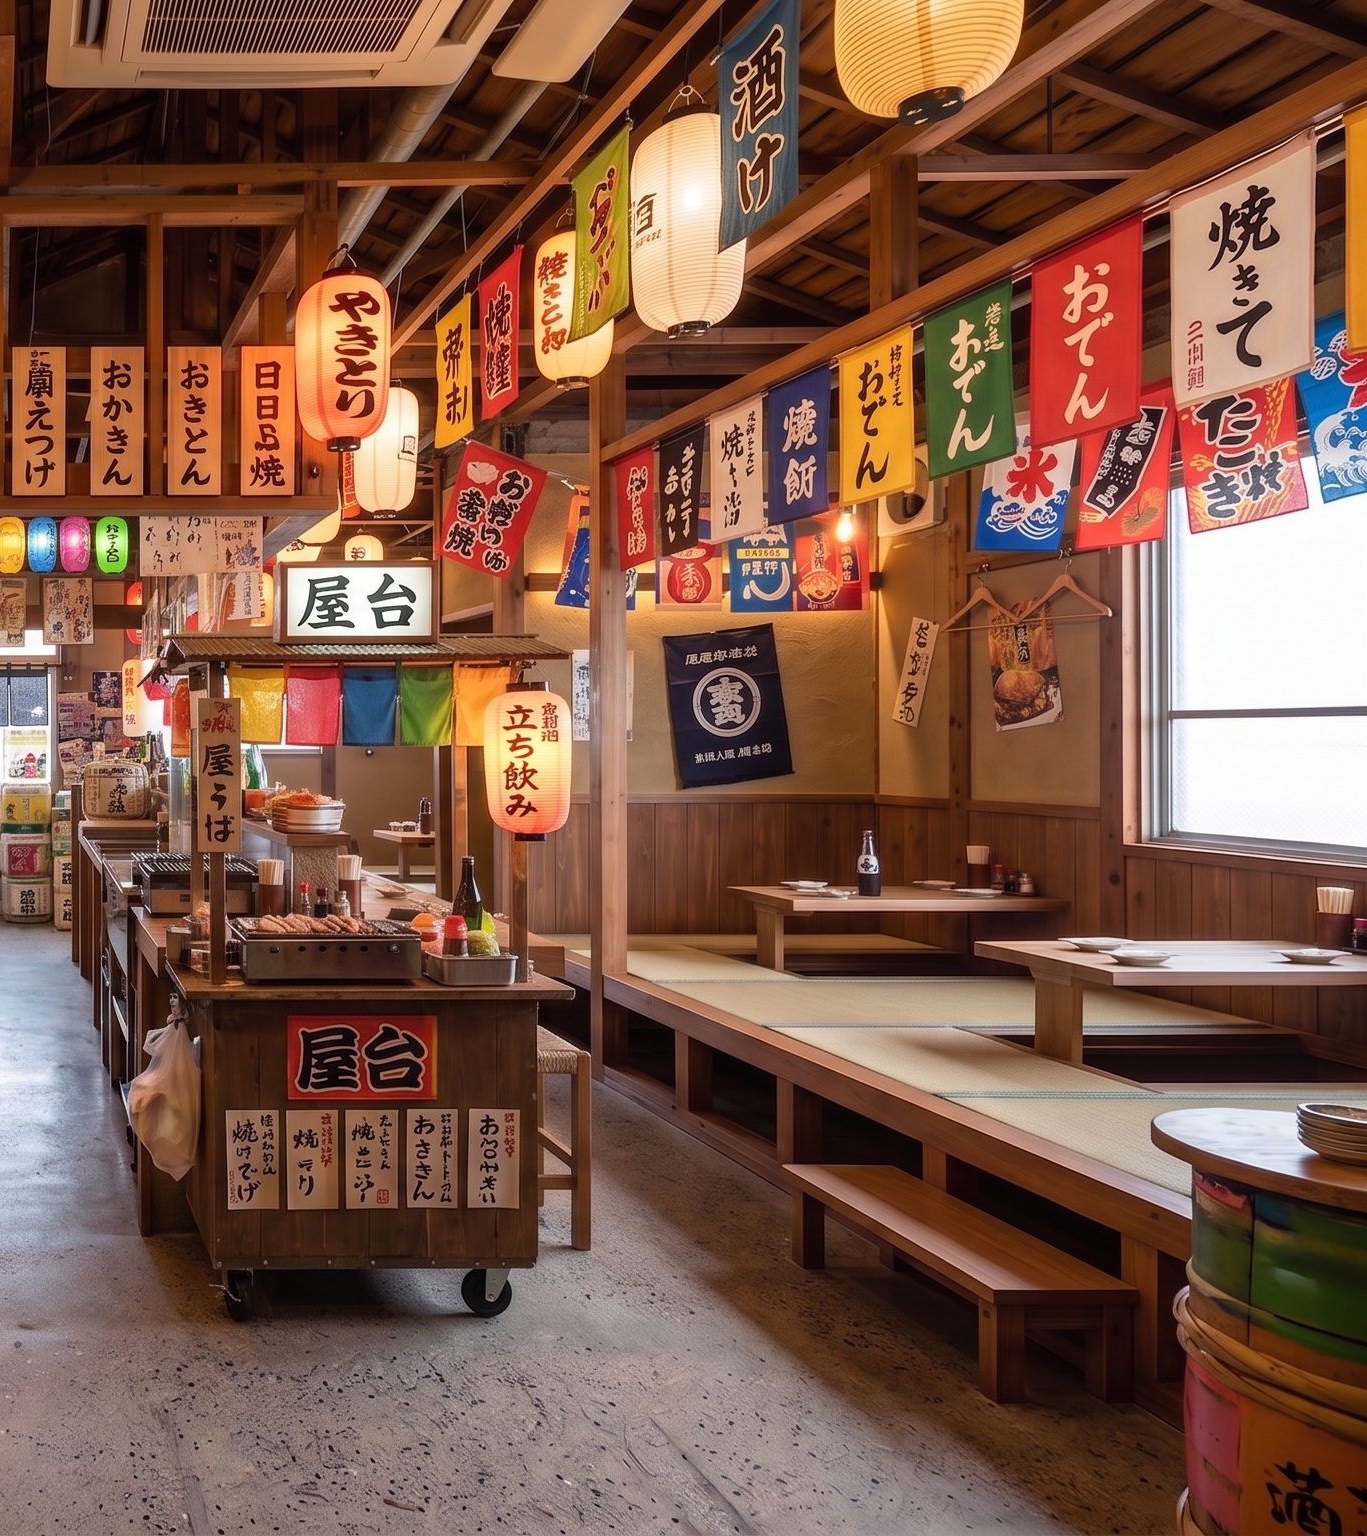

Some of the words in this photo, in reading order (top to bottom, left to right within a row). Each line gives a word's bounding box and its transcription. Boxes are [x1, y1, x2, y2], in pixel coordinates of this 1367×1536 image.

[328, 290, 381, 419] やきとり
[947, 319, 995, 460] おでん
[1062, 262, 1114, 424] おでん
[102, 360, 133, 486] おかきん
[180, 360, 211, 486] おきとん
[1007, 446, 1059, 504] 氷
[297, 573, 417, 629] 屋台
[502, 704, 539, 817] 立ち飲み
[296, 1024, 427, 1093] 屋台
